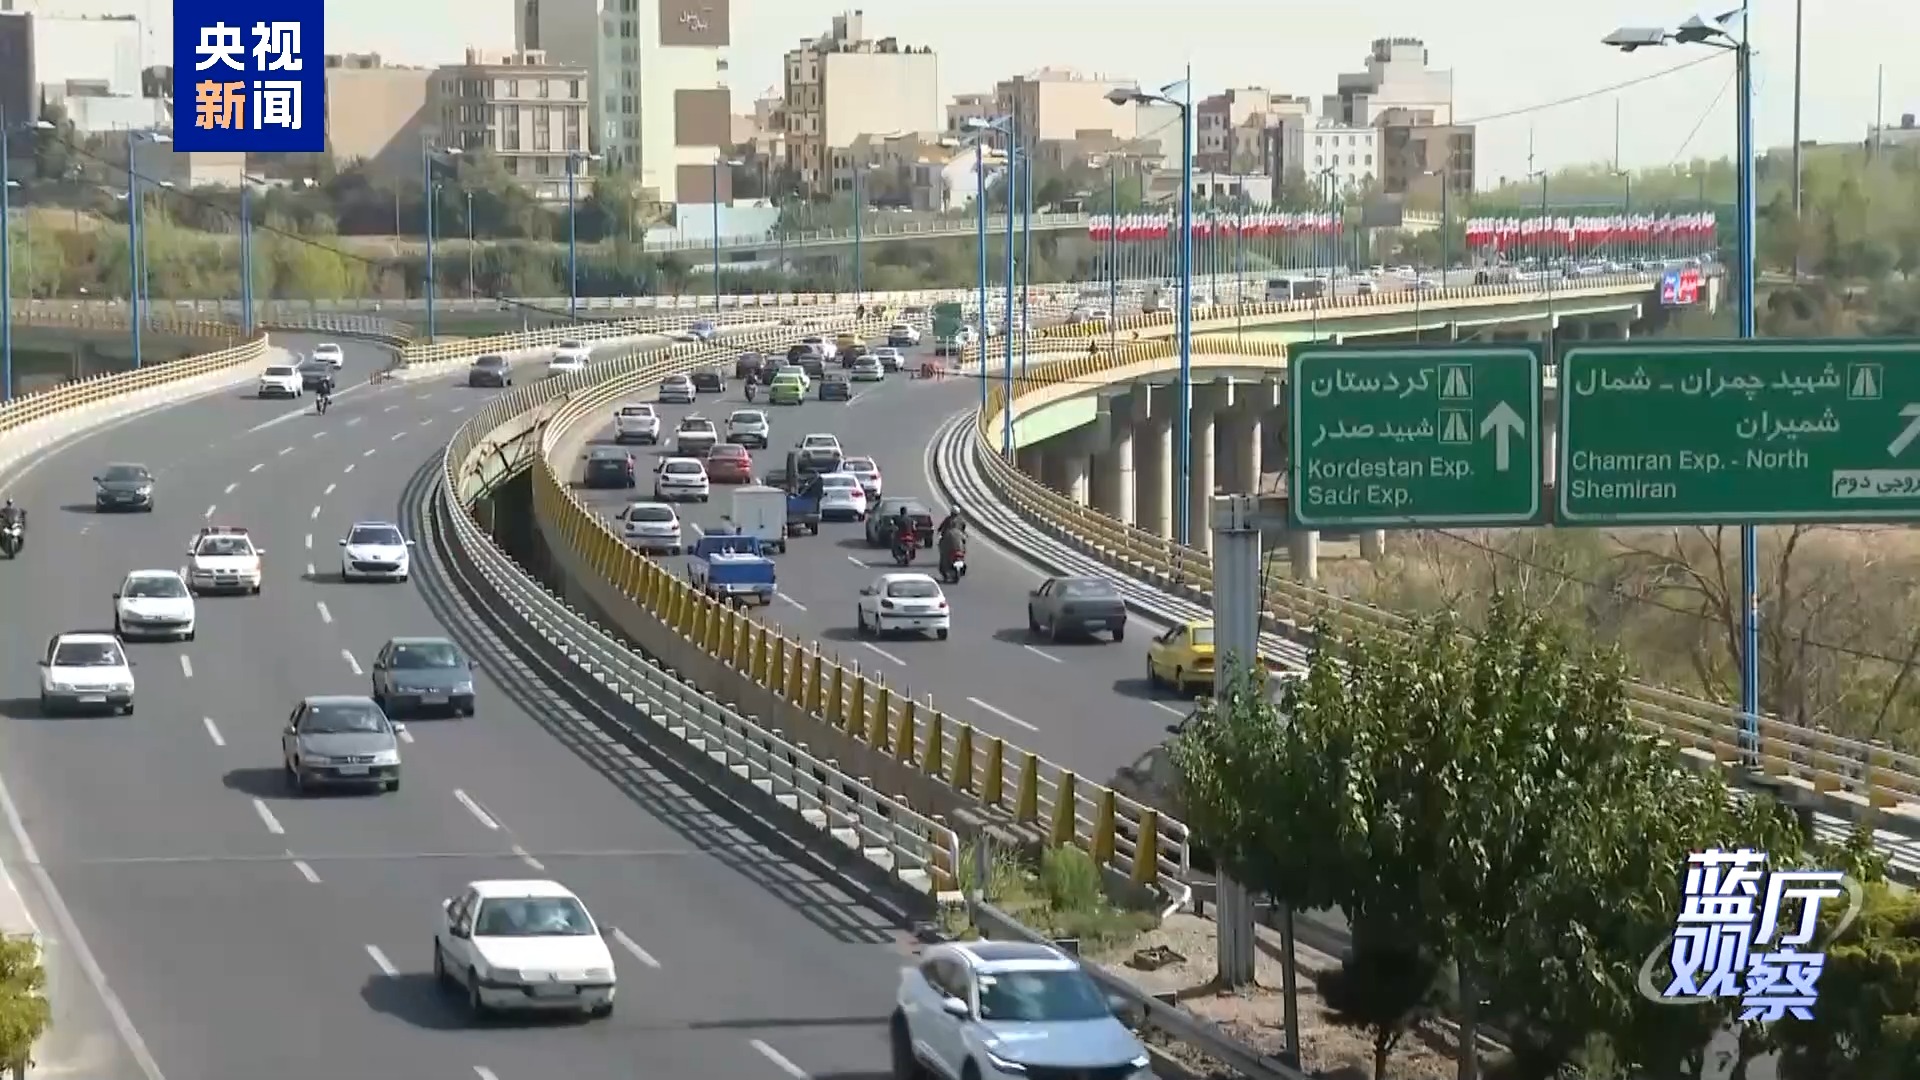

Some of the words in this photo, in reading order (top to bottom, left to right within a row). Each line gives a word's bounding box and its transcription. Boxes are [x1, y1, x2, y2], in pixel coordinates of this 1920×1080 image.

[1311, 368, 1434, 399] کردستان
[1575, 365, 1651, 396] شمال
[1681, 368, 1765, 401] چمران
[1771, 362, 1840, 393] شهید
[1311, 419, 1374, 447] صدر
[1379, 417, 1434, 442] شهید
[1736, 407, 1841, 442] شمیران
[1308, 457, 1423, 479] Kordestan
[1430, 456, 1475, 479] Exp.
[1572, 450, 1672, 471] Chamran
[1679, 450, 1725, 473] Exp.
[1747, 448, 1809, 469] North
[1308, 484, 1360, 505] Sadr
[1367, 484, 1414, 507] Exp.
[1571, 479, 1677, 499] Shemiran
[1834, 475, 1871, 497] دوم
[1876, 475, 1920, 494] روجی
